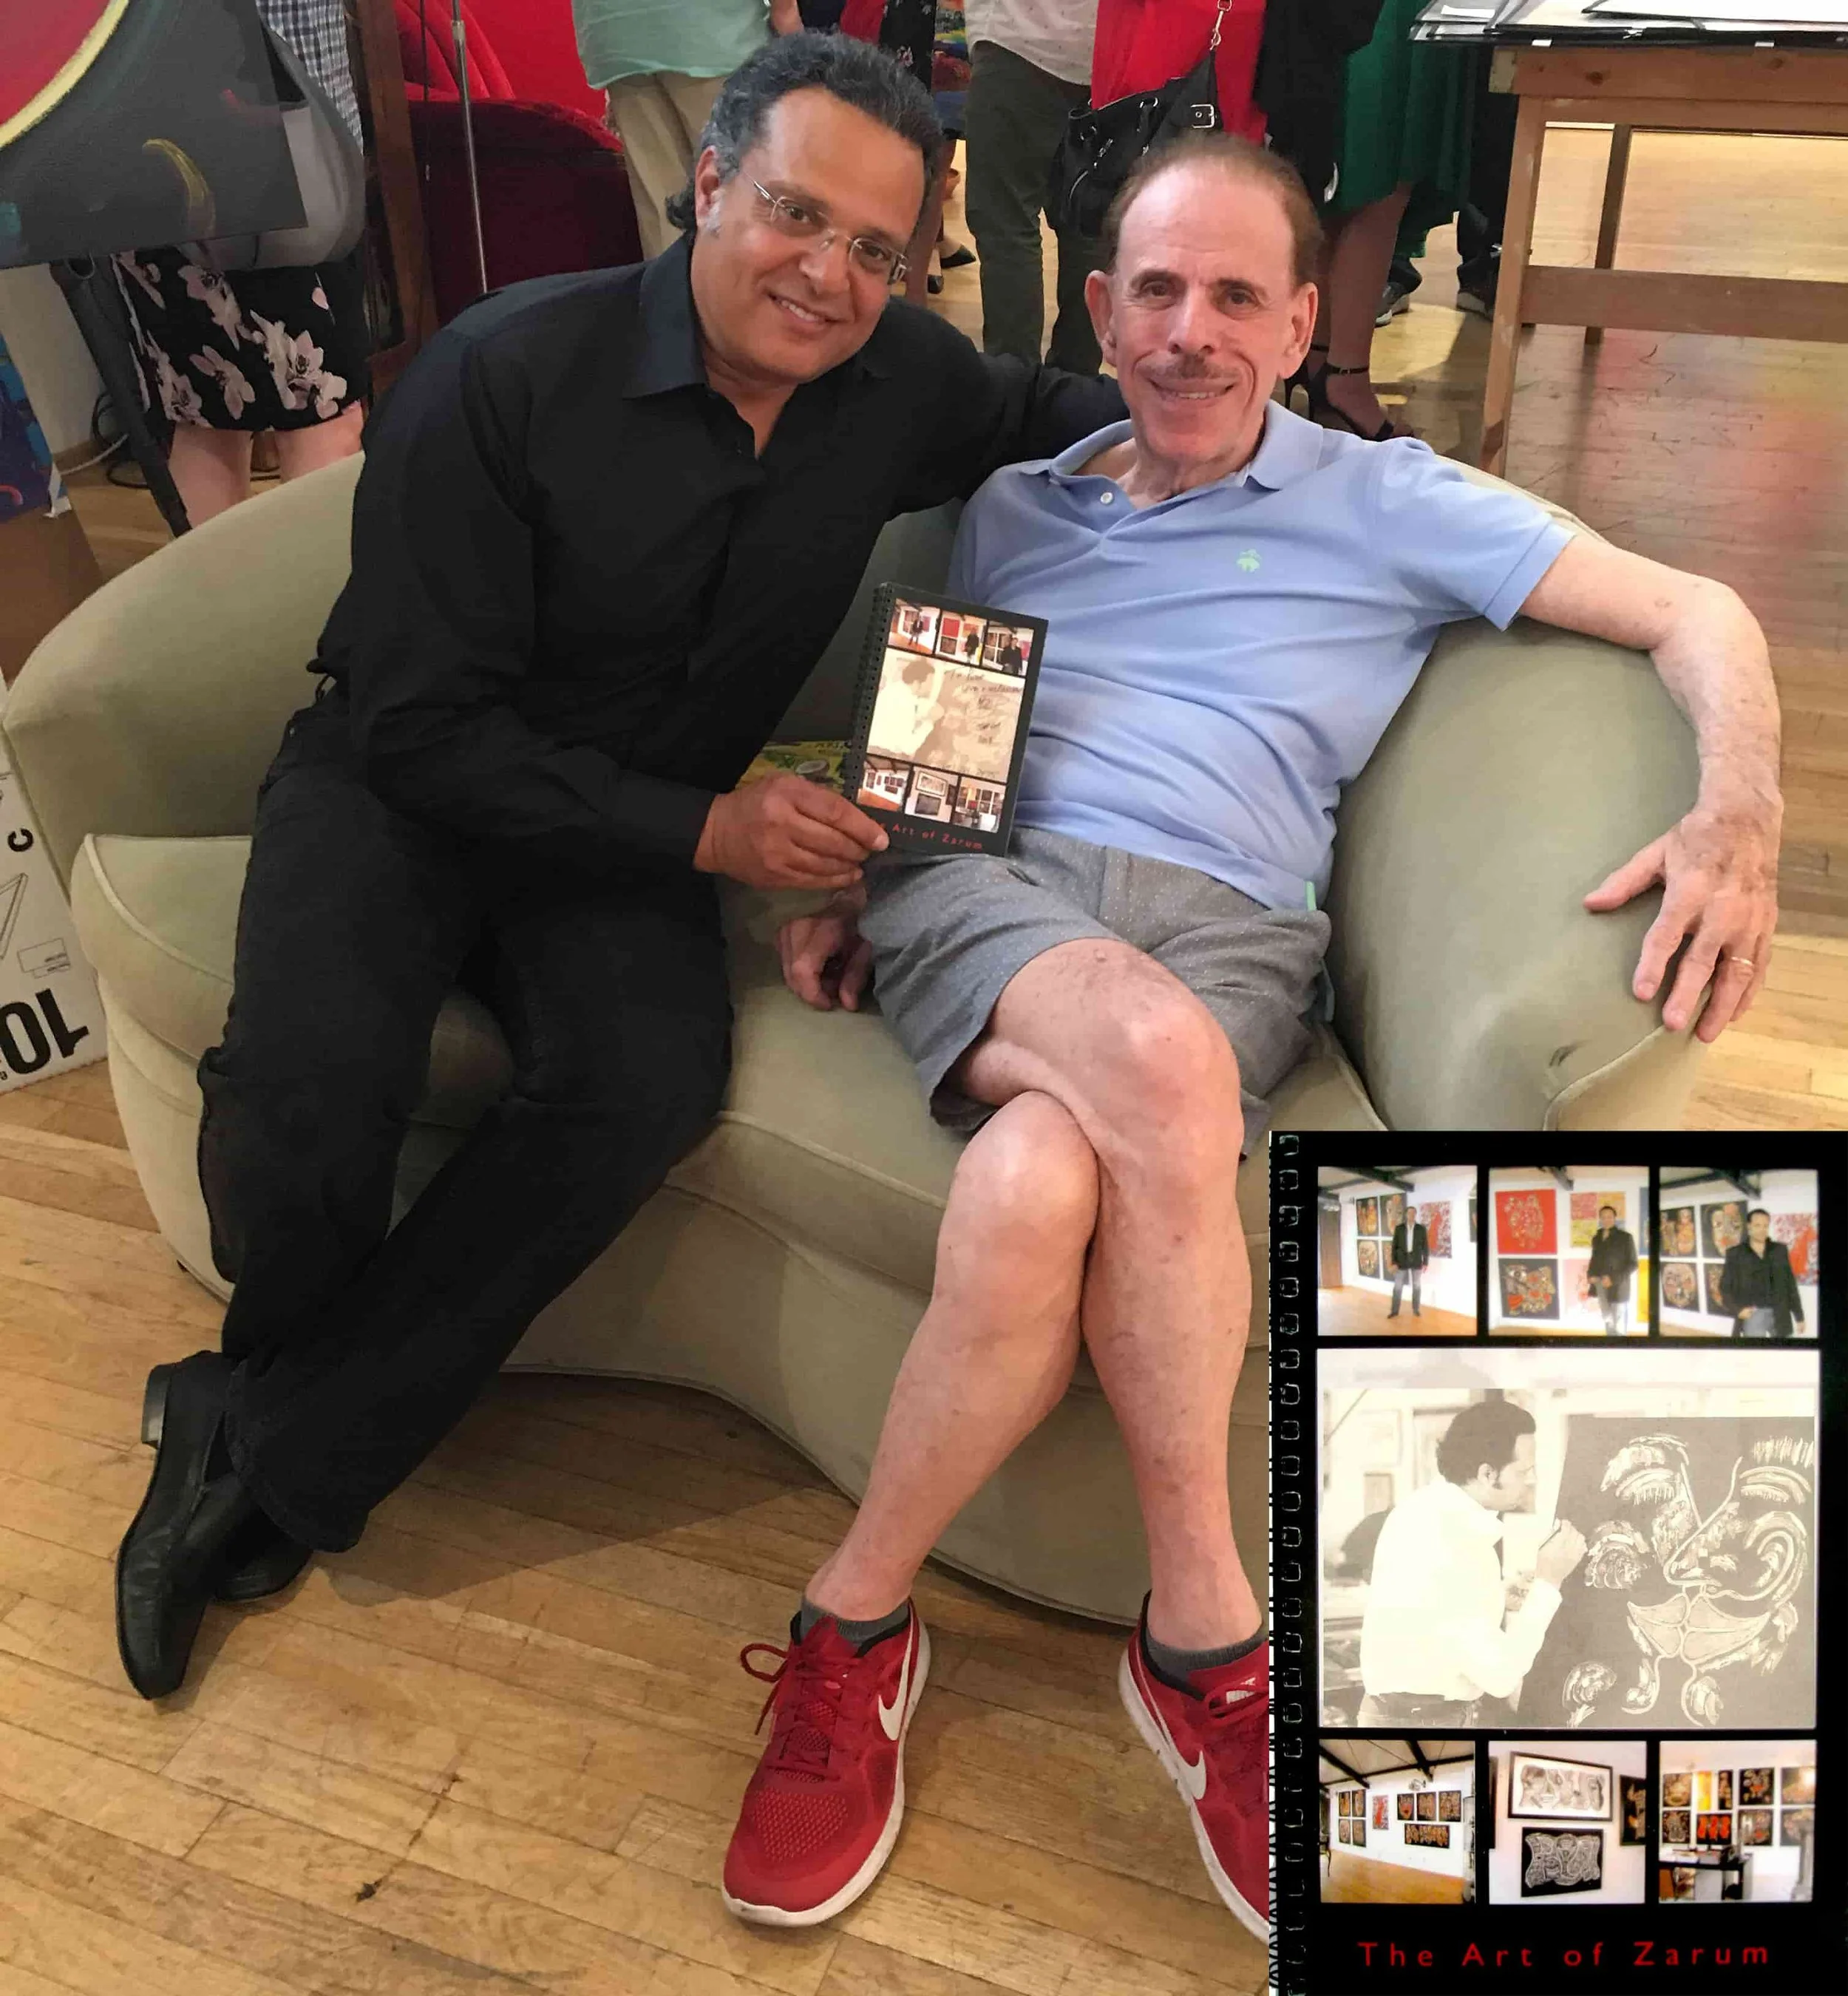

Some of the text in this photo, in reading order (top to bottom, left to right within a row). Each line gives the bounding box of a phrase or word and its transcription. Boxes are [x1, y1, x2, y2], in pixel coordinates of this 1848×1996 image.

[892, 823, 915, 835] Art
[922, 829, 936, 839] of
[942, 832, 982, 849] Zarum
